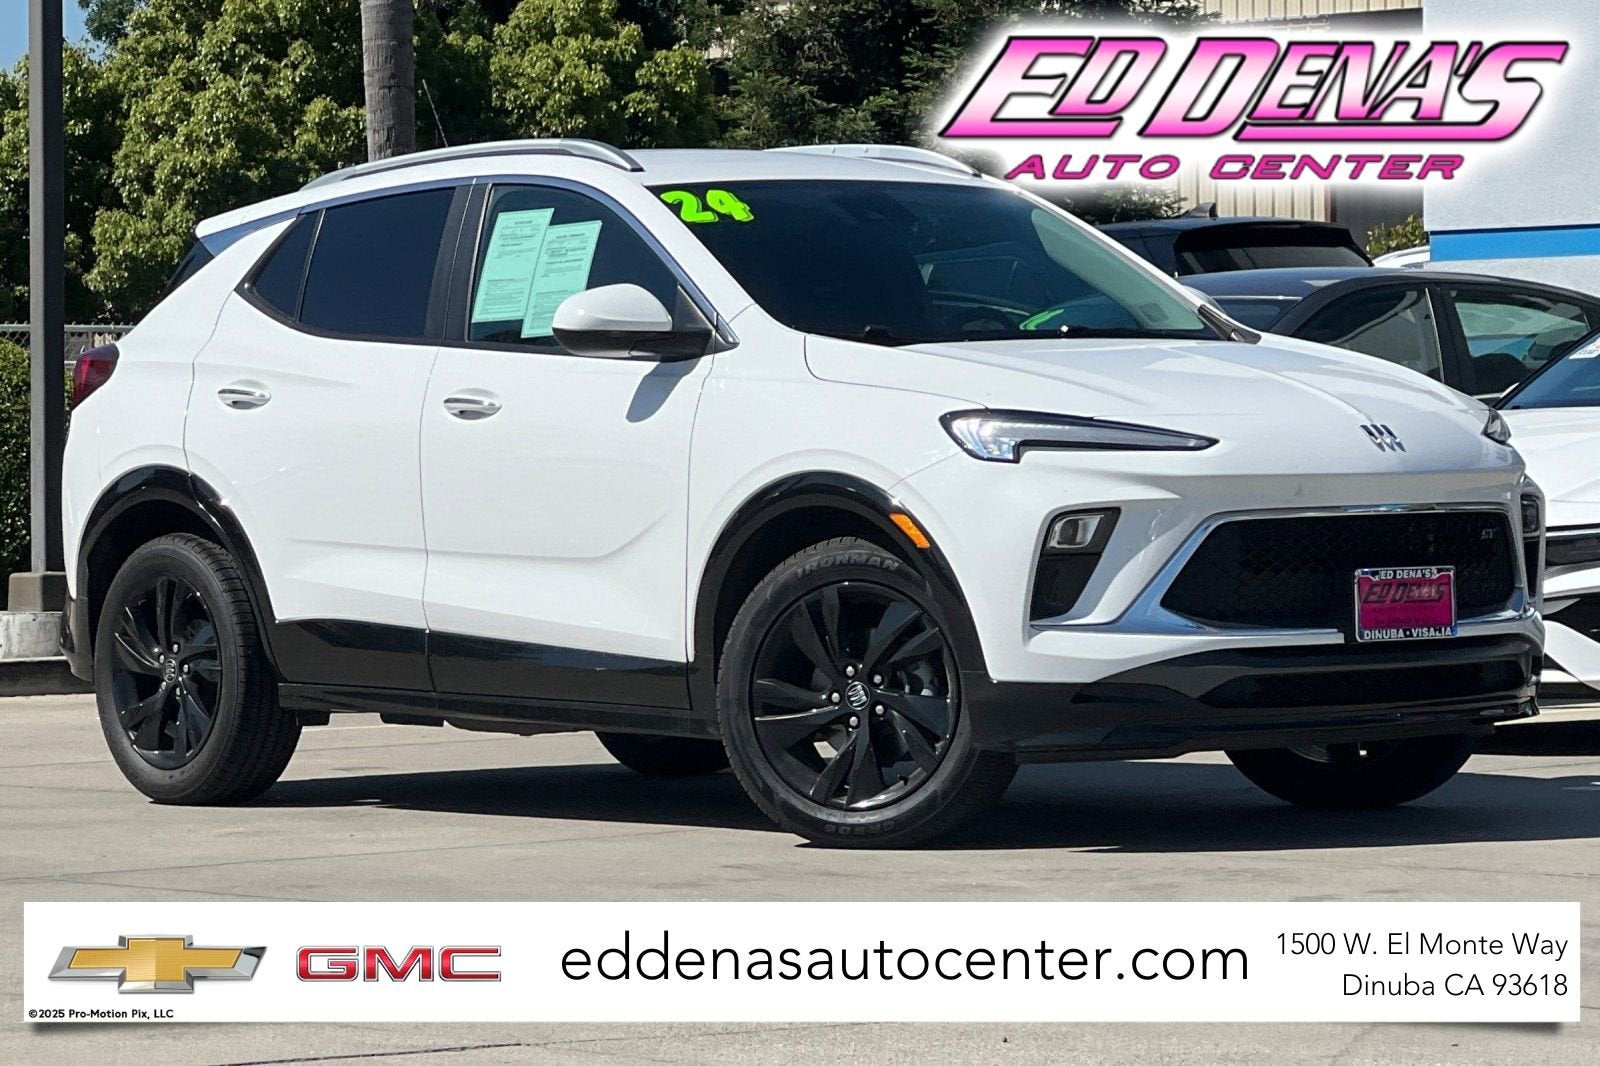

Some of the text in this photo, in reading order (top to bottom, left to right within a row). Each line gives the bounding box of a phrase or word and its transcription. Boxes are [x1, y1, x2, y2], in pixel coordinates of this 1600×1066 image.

[660, 189, 755, 223] 24
[797, 550, 900, 578] IRONMAN
[1380, 568, 1433, 580] ED DENA'S
[1364, 629, 1405, 640] DINUBA
